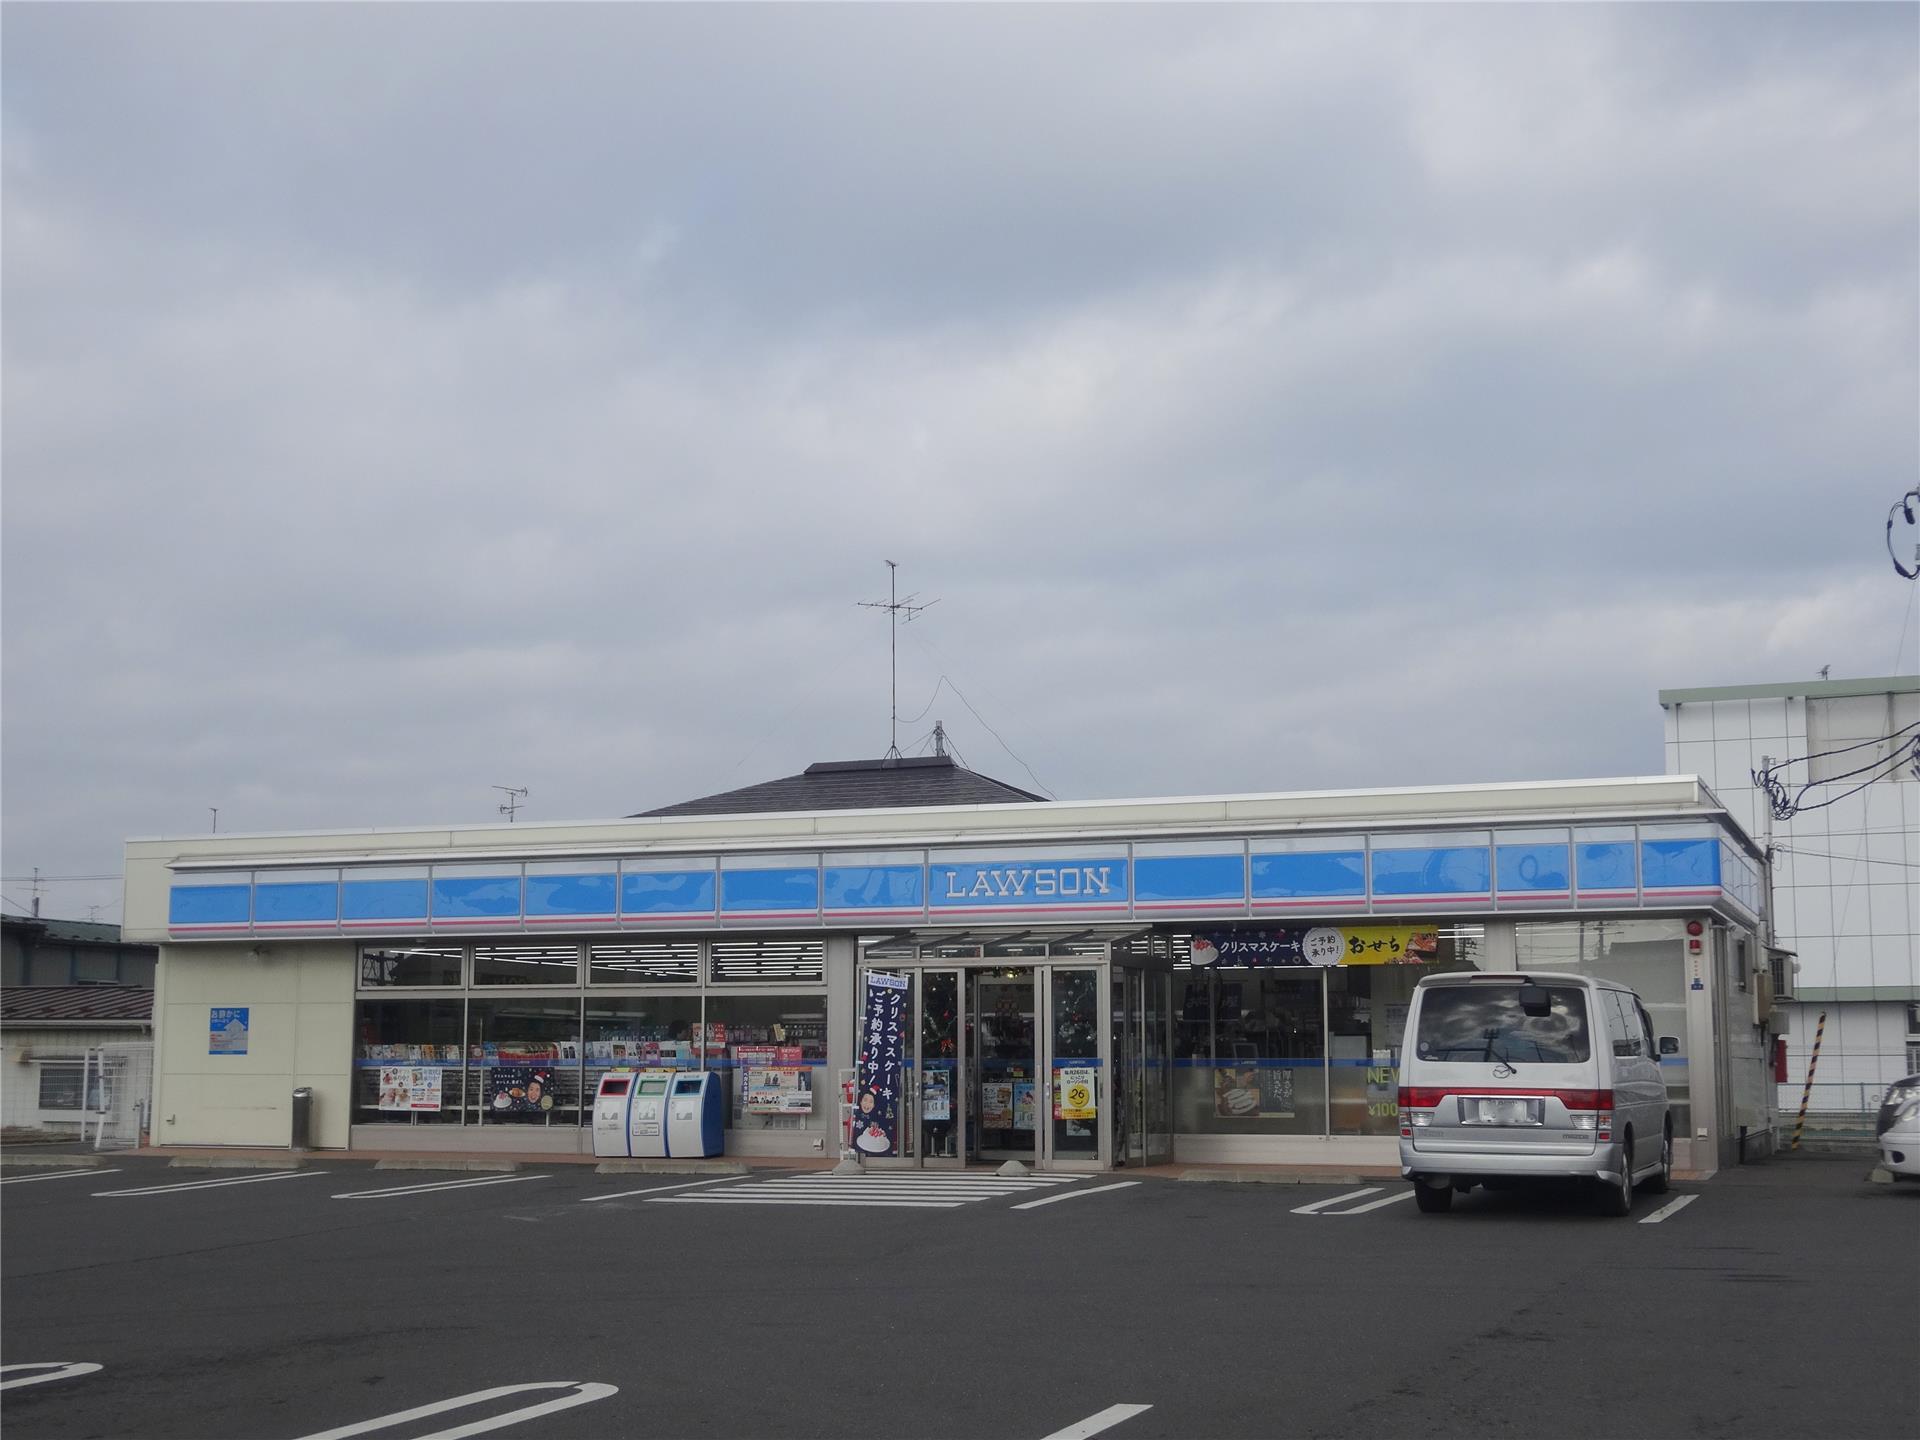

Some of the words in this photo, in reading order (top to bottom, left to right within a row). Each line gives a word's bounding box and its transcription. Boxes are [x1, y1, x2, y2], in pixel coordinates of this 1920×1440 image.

[946, 866, 1111, 899] LAWSON
[1220, 940, 1301, 954] クリスマスケーキ
[1310, 935, 1336, 947] ご予約
[1348, 936, 1401, 954] おせち
[870, 976, 907, 988] LAWSON
[882, 993, 901, 1100] クリスマスケーキ
[1069, 1088, 1085, 1100] 26
